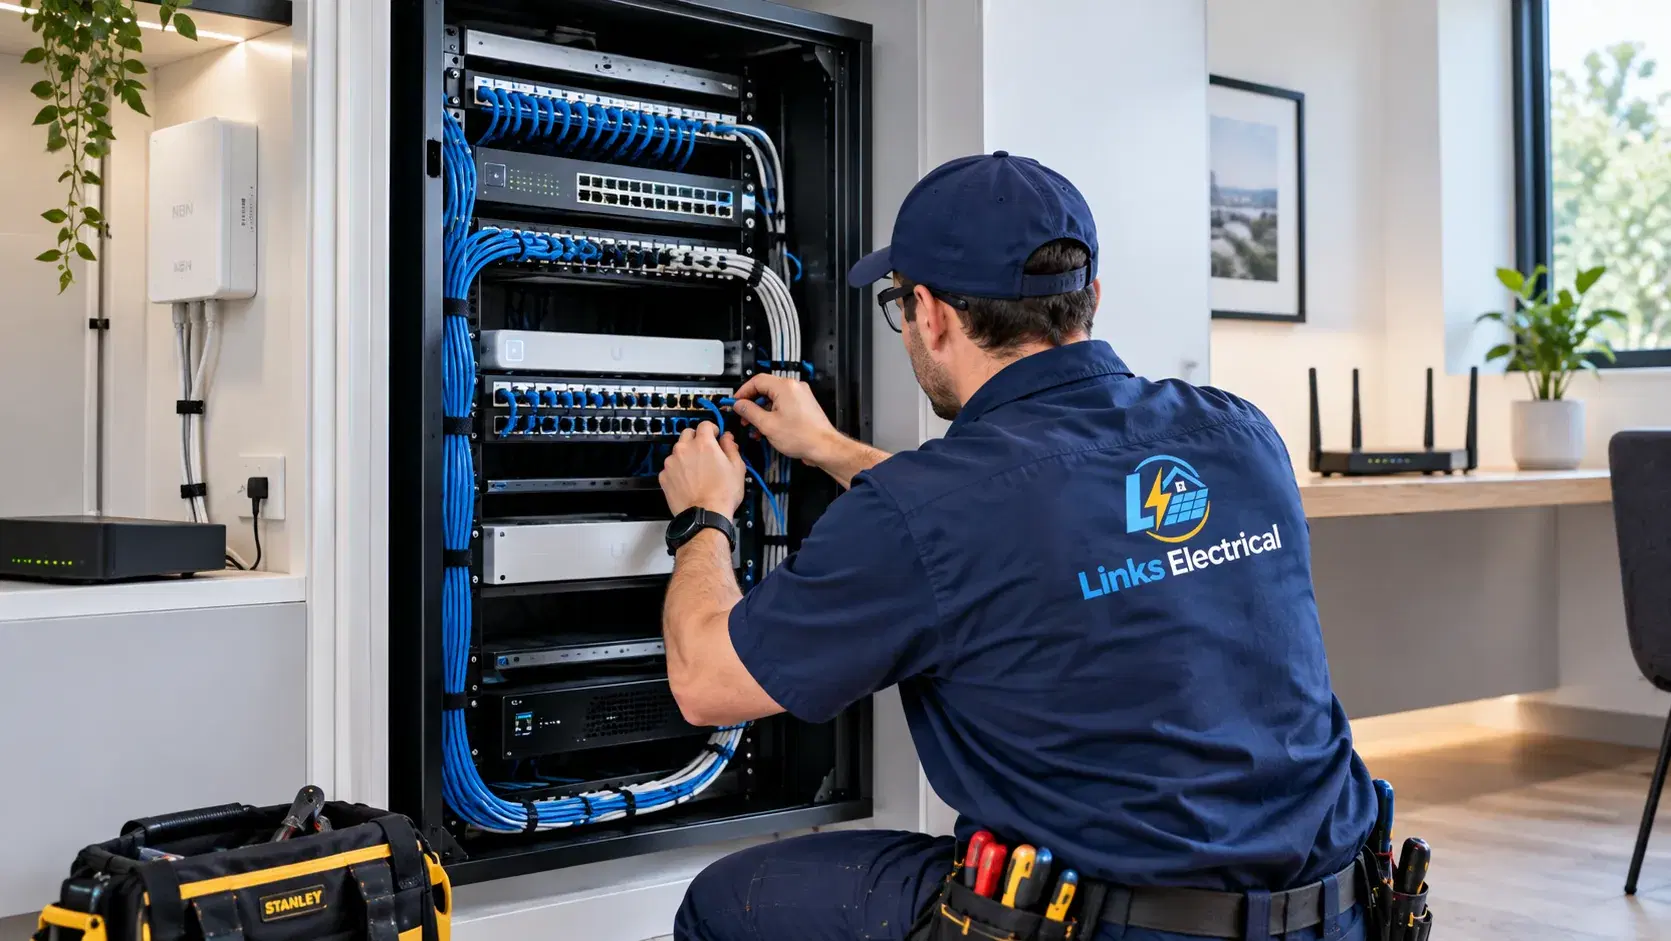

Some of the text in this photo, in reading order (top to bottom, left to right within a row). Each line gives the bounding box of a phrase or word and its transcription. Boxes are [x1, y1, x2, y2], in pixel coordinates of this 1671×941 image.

[172, 202, 194, 218] NBN
[1078, 524, 1282, 600] Links Electrical
[265, 890, 322, 915] STANLEY
